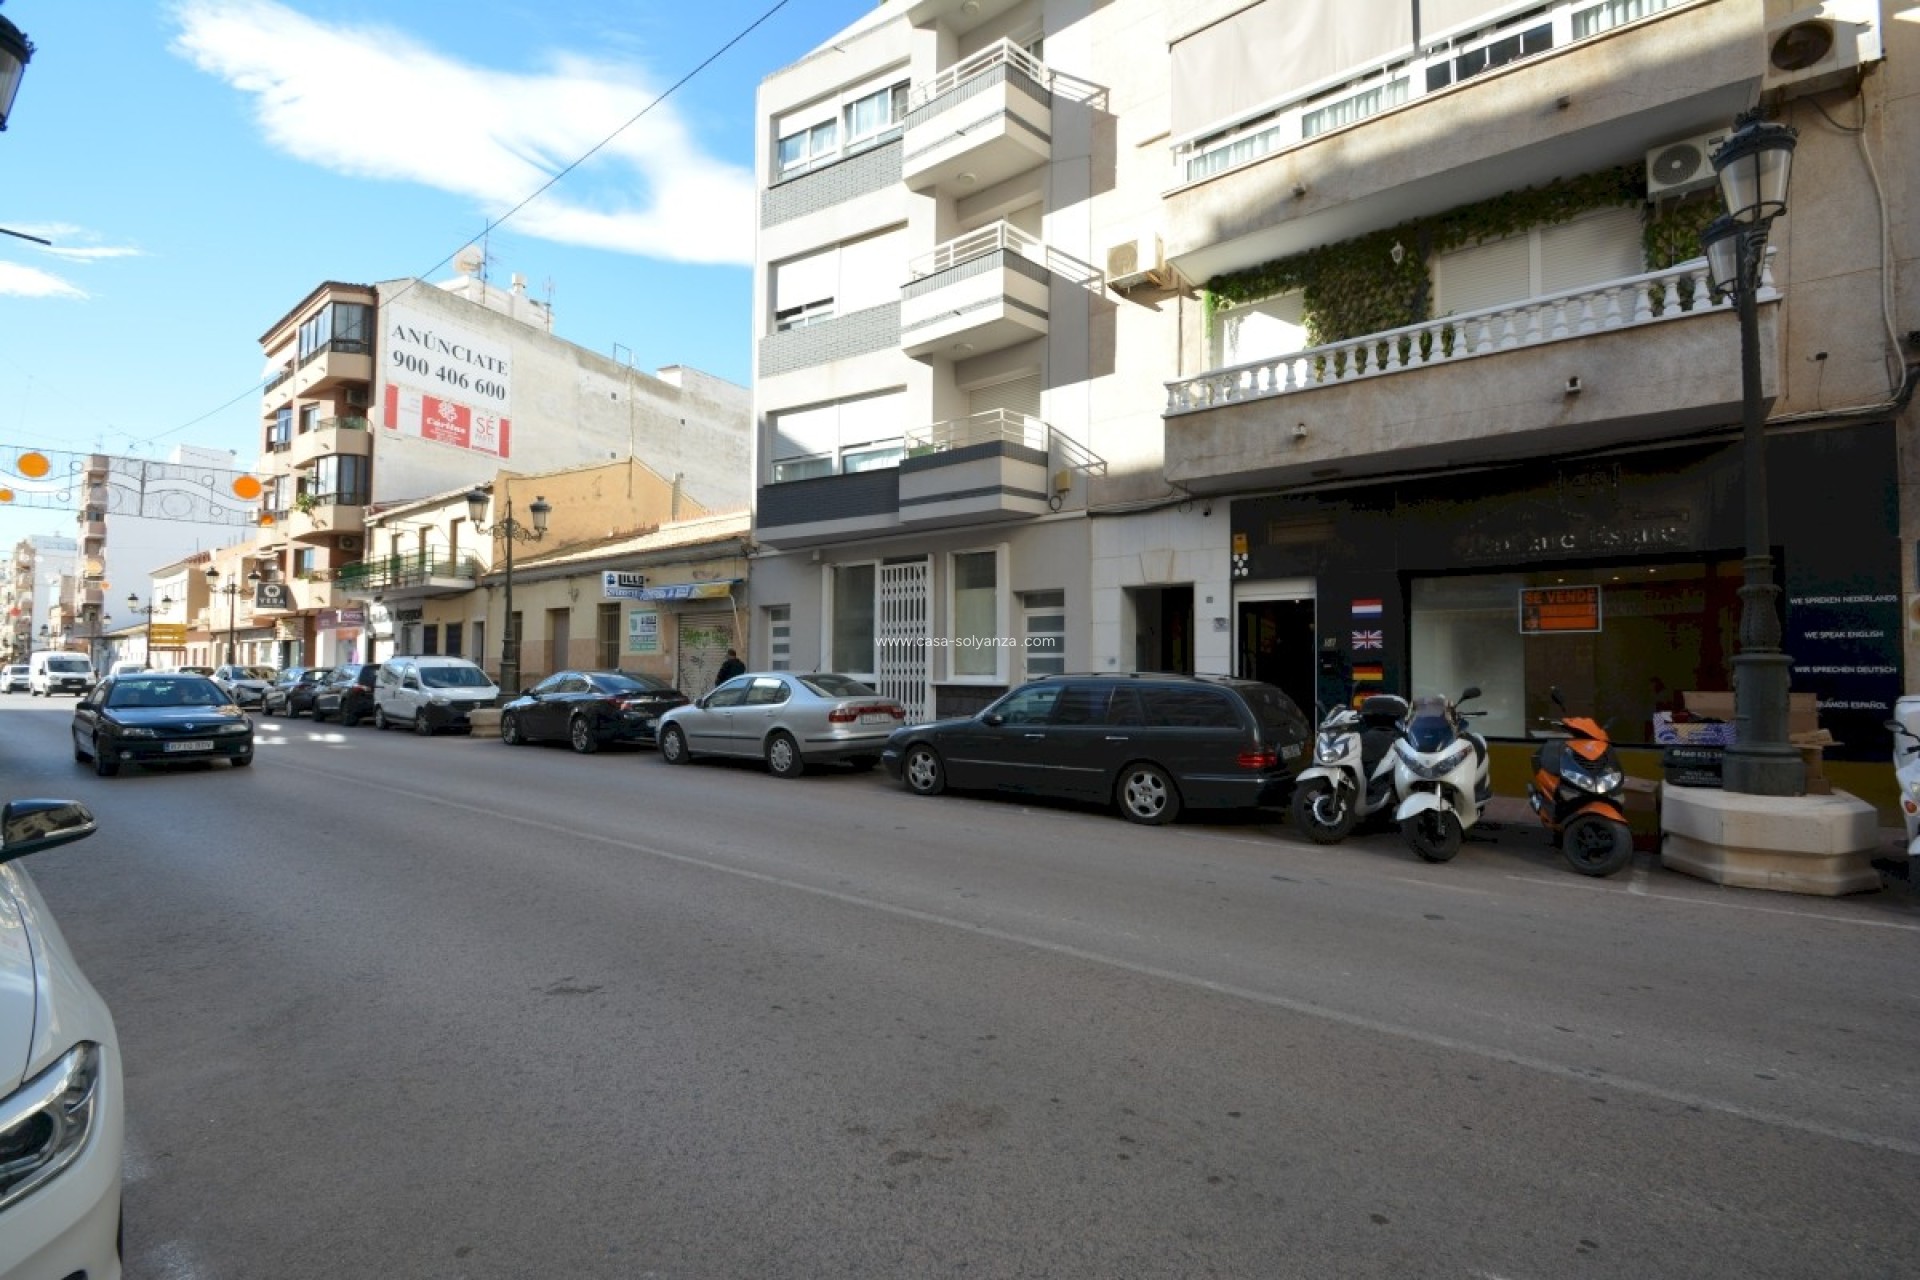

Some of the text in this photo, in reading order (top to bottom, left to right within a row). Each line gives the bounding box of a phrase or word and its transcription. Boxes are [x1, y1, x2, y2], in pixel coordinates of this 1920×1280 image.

[392, 324, 508, 376] ANÚNCIATE
[393, 350, 506, 401] 900 406 600
[1790, 597, 1803, 605] WE
[1804, 630, 1884, 639] WE SPEAK ENGLISH
[1812, 666, 1855, 674] SPRECHEN
[1856, 666, 1897, 674] DEUTSCH
[1850, 700, 1889, 709] ESPAÑOL
